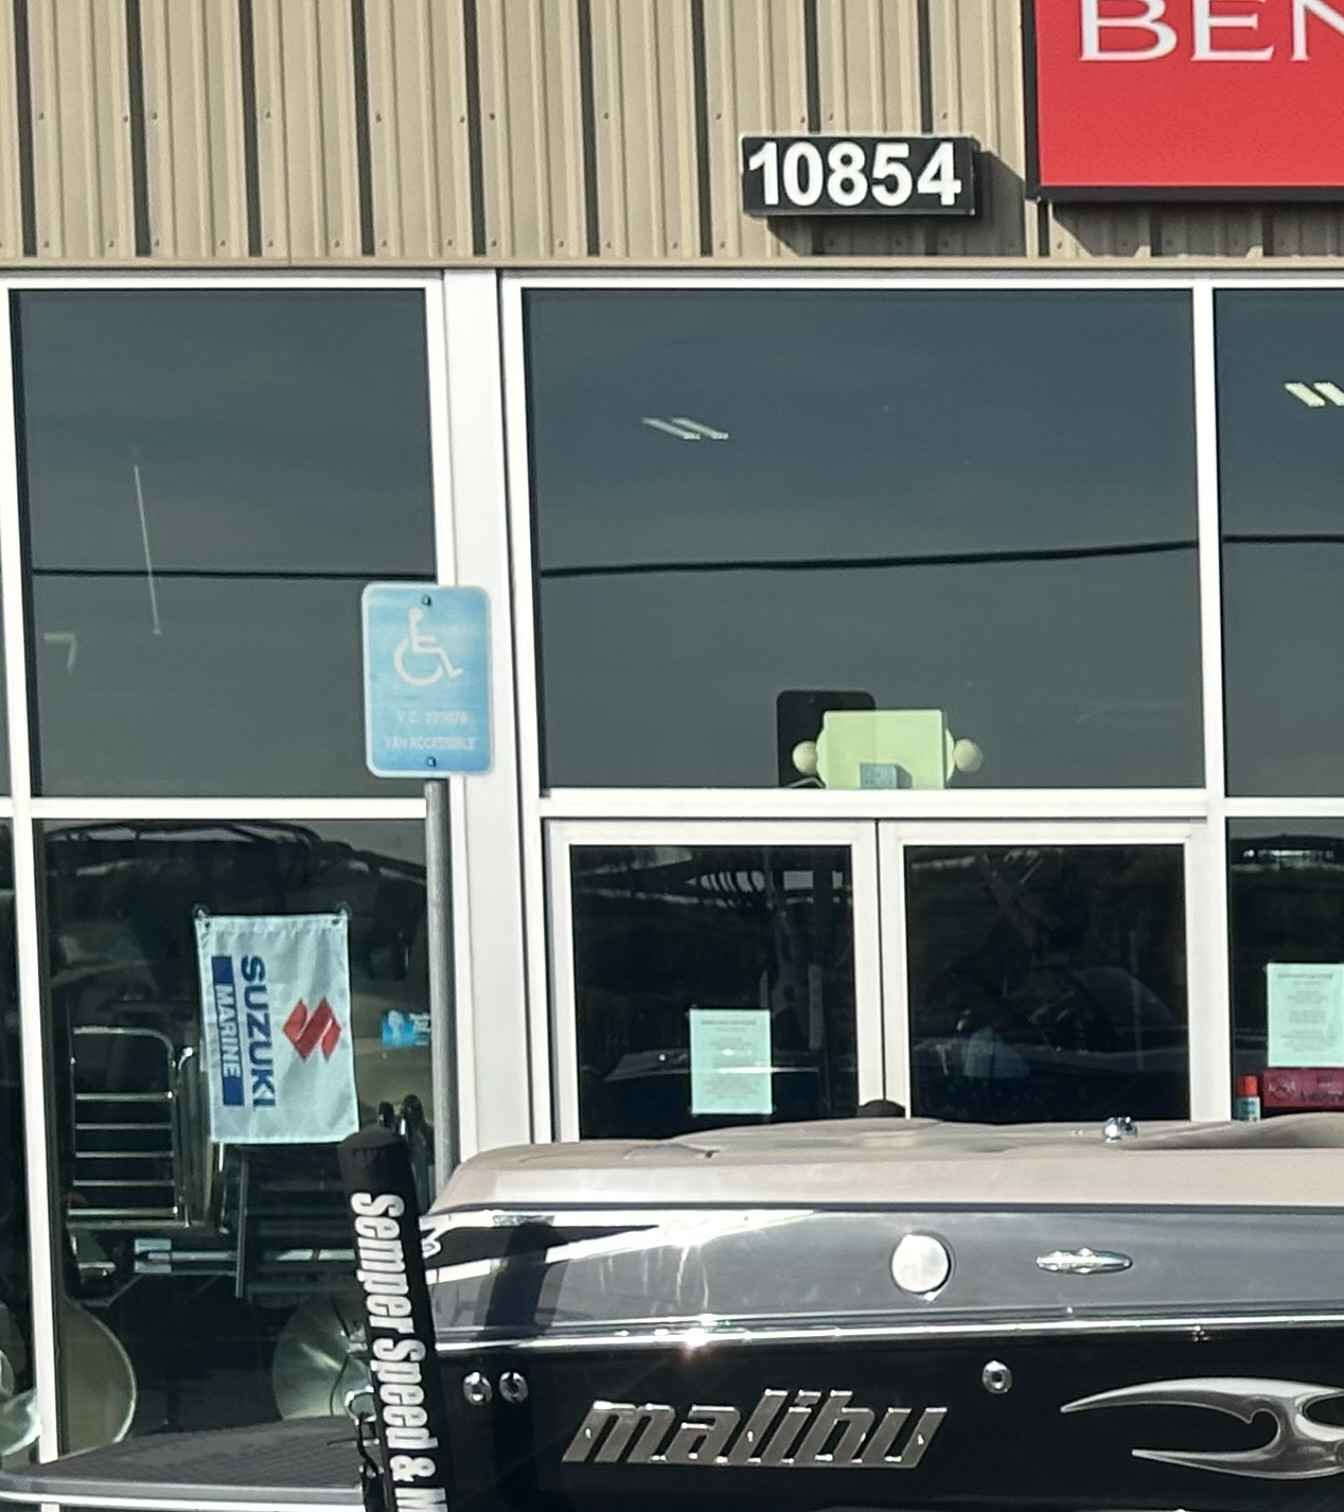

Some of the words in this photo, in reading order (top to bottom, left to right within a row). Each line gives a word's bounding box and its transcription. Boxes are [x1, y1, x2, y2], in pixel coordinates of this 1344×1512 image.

[747, 140, 961, 207] 10854
[215, 983, 242, 1078] MARINE
[241, 955, 276, 1107] SUZUKI
[351, 1192, 415, 1334] Semper
[370, 1338, 438, 1449] Speed
[562, 1388, 948, 1469] malibu
[389, 1455, 436, 1482] &
